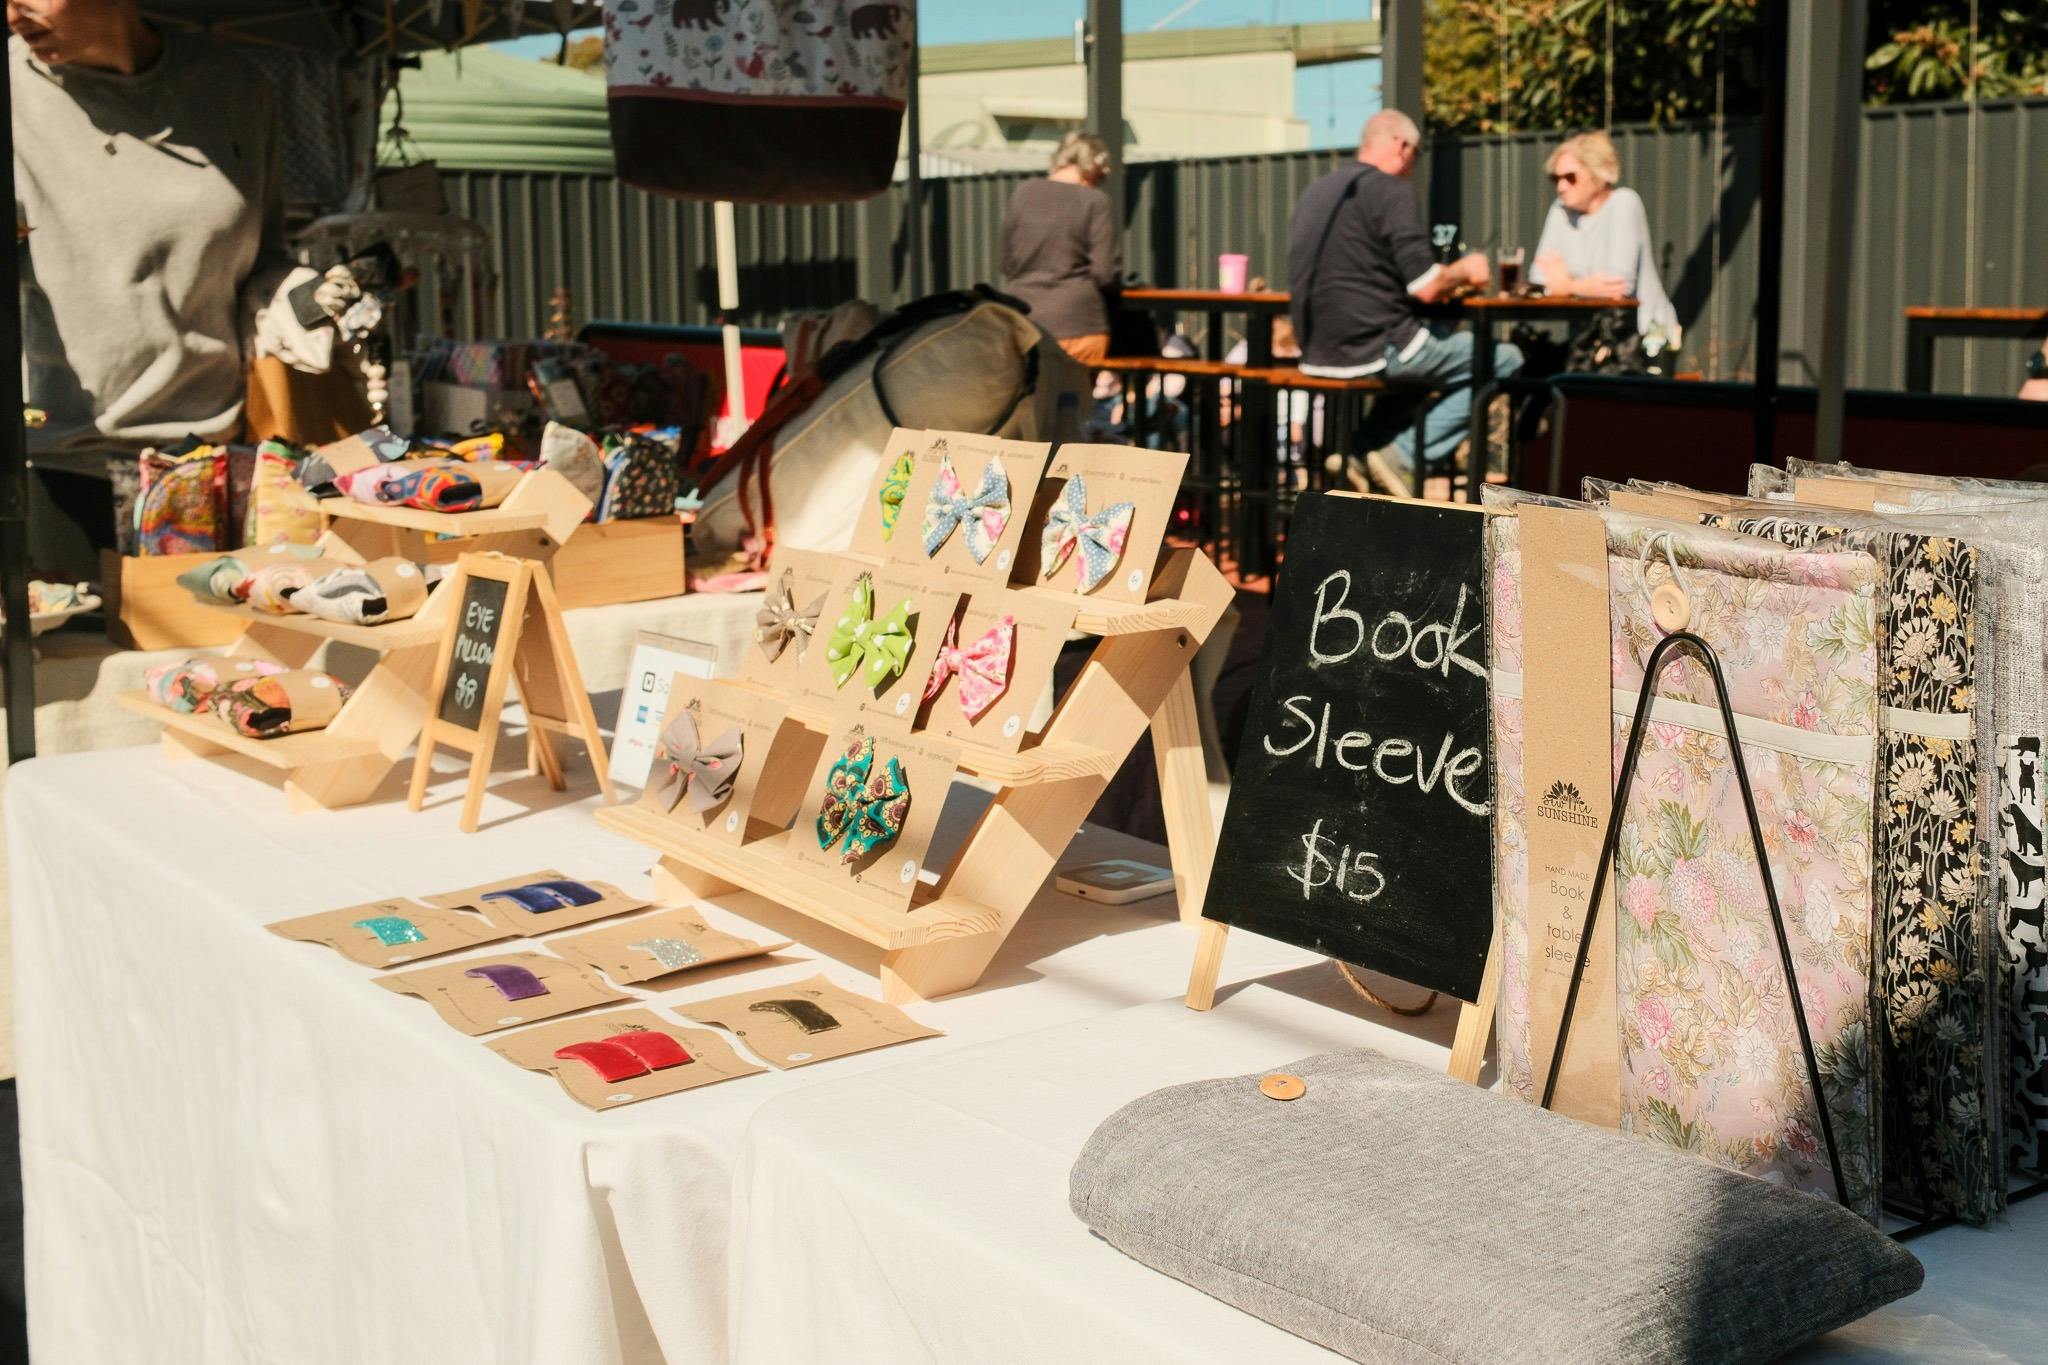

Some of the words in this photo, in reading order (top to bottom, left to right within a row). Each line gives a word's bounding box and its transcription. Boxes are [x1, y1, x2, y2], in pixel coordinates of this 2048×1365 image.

[1432, 224, 1458, 246] 37
[465, 601, 495, 633] EYE
[1310, 569, 1490, 678] Book
[455, 672, 478, 710] $8
[1264, 695, 1492, 816] Sleeve
[1537, 805, 1598, 829] SUNSHINE
[1286, 818, 1386, 901] $15
[1544, 863, 1566, 876] HAND
[1567, 869, 1591, 882] MADE
[1550, 879, 1585, 901] Book
[1562, 905, 1573, 921] &
[1546, 922, 1583, 944] table
[1545, 944, 1591, 968] sleee
